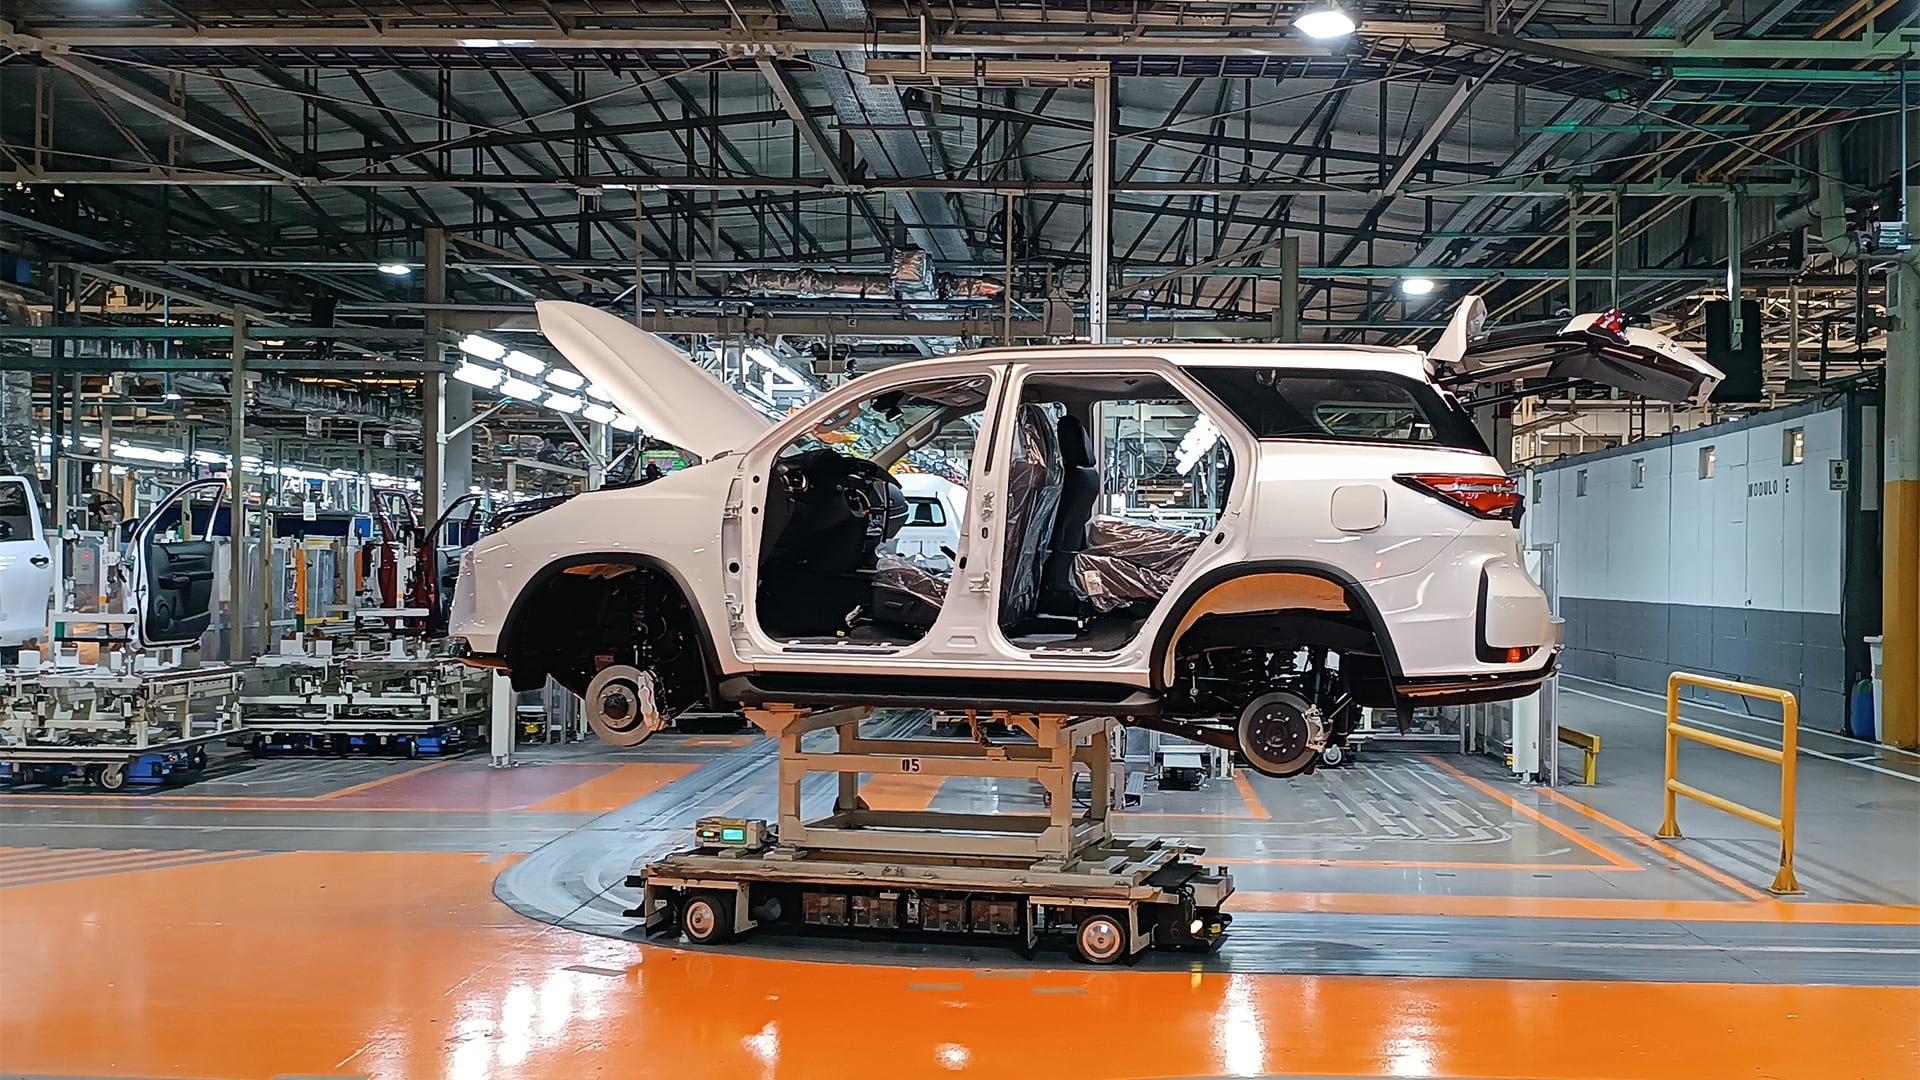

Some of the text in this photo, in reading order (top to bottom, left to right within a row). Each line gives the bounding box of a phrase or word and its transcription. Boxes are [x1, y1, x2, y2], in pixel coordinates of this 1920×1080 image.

[1748, 478, 1790, 497] MODULO E
[901, 758, 920, 772] 05
